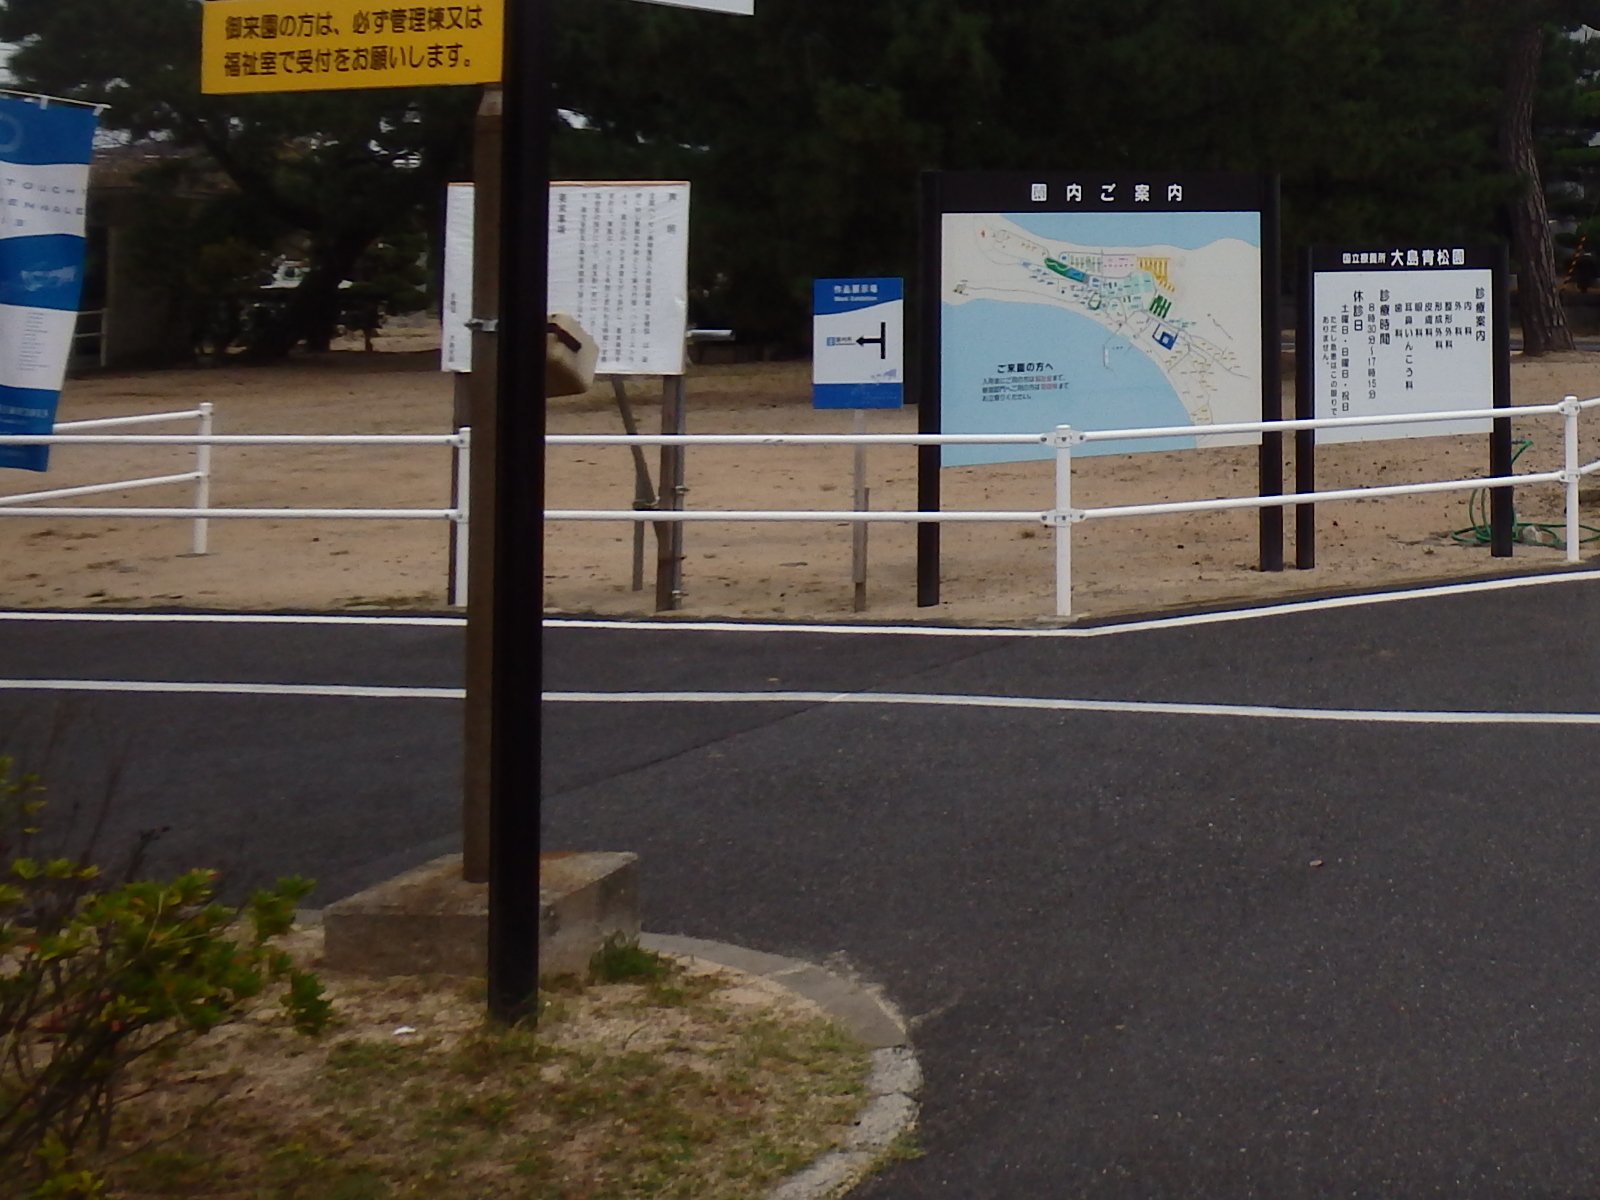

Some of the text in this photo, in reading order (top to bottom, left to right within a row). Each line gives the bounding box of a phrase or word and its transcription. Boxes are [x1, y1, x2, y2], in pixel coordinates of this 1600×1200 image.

[225, 5, 483, 40] 御来園の方は、必ず管理棟又は
[224, 43, 471, 78] 福祉室で受付をお願いします。
[1031, 183, 1183, 202] 園内ご案内
[1391, 249, 1465, 266] 大島青松園
[1353, 289, 1364, 332] 休診日
[1379, 289, 1391, 345] 診療時間
[1475, 287, 1486, 341] 診療案内
